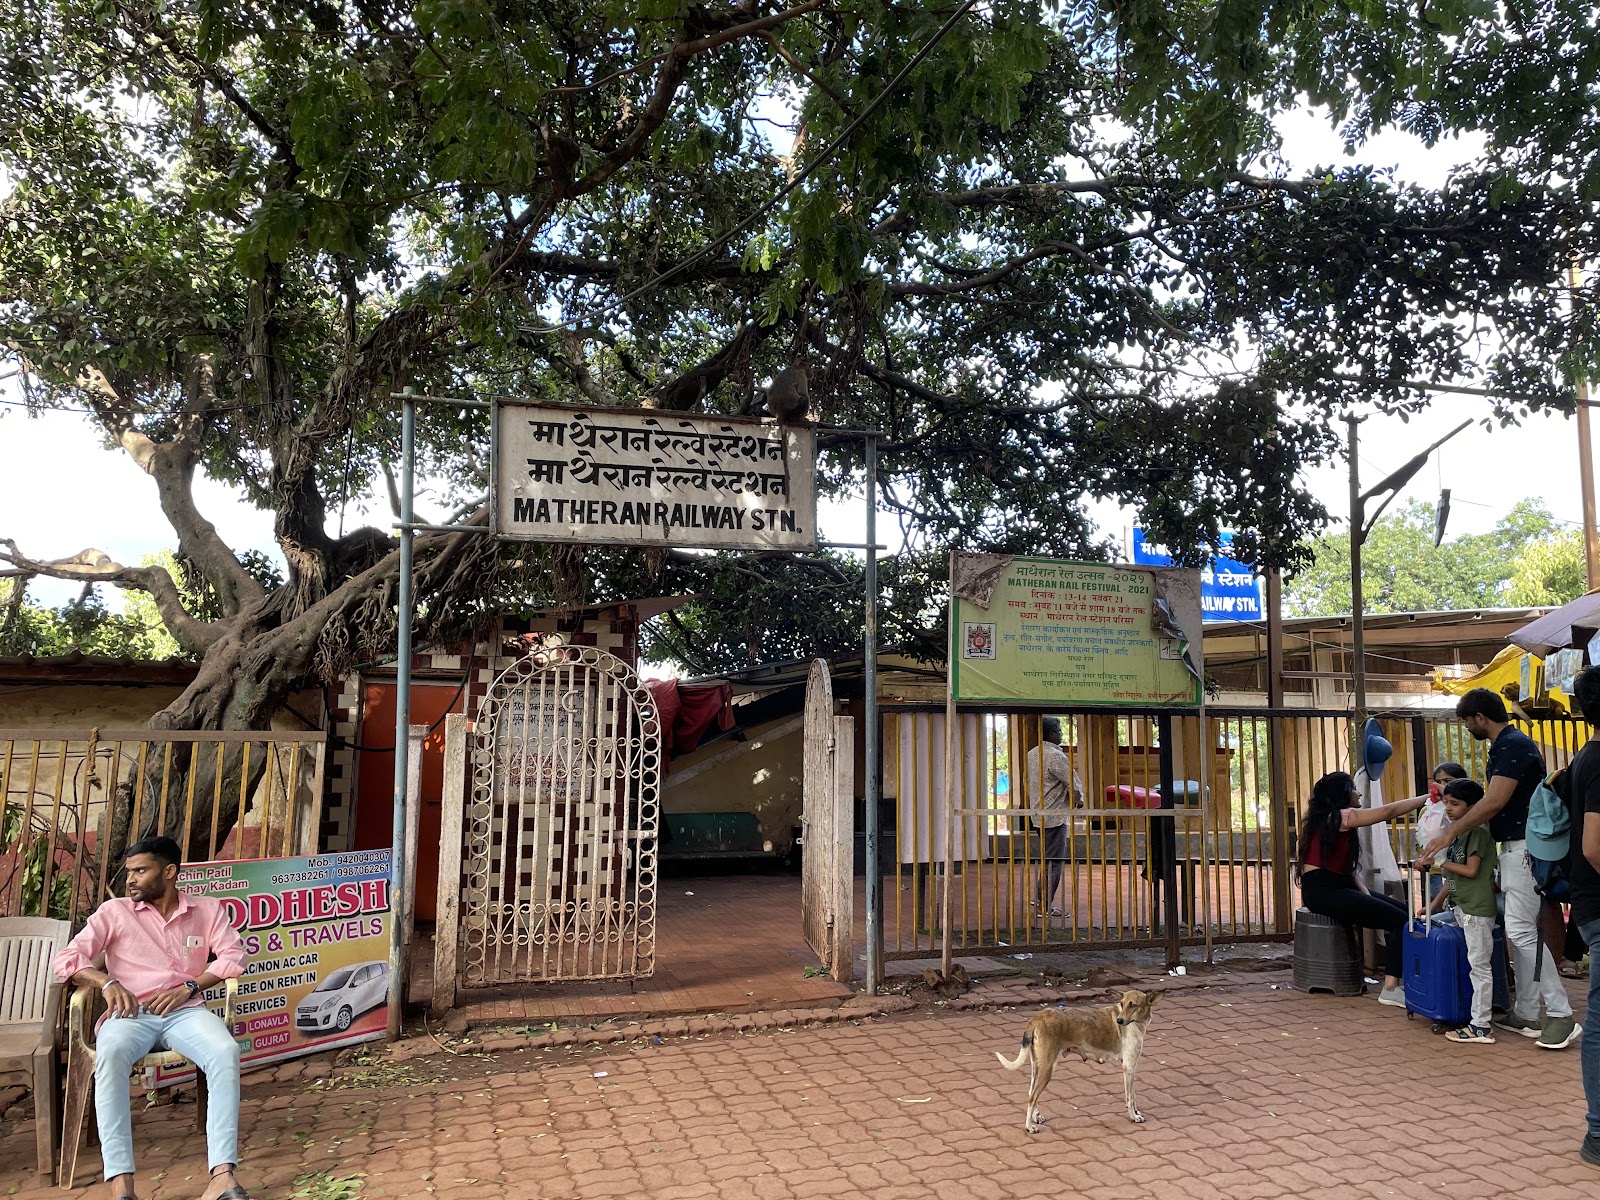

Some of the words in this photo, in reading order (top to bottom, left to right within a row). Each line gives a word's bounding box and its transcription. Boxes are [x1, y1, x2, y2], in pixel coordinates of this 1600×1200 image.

[528, 413, 654, 454] माथेरान
[708, 426, 783, 463] स्टेशन
[527, 450, 656, 491] माथेरान
[706, 460, 786, 497] स्टेशन
[513, 497, 650, 525] MATHERAN
[654, 501, 746, 530] RAILWAY
[751, 508, 803, 533] STN.
[1016, 565, 1056, 578] माथेरान
[1058, 566, 1074, 579] रेल
[1077, 570, 1105, 580] उत्सव
[1217, 568, 1253, 587] स्टेशन
[1008, 578, 1057, 588] MATHERAN
[1060, 580, 1079, 590] RAIL
[1082, 582, 1120, 592] FESTIVAL
[1129, 586, 1149, 594] 2021
[1031, 589, 1056, 599] दिनांक
[1081, 602, 1087, 611] से
[1133, 607, 1146, 615] तक
[1236, 597, 1259, 612] STN.
[1019, 612, 1038, 620] स्थान
[1046, 611, 1073, 621] माथेरान
[1076, 613, 1087, 622] रेल
[1089, 613, 1111, 623] स्टेशन
[1113, 615, 1135, 624] परिसर
[337, 851, 390, 865] 9420040307
[177, 869, 203, 882] chin
[207, 867, 231, 878] Patil
[271, 870, 329, 884] 9637382261
[337, 863, 389, 877] 9987062261
[179, 884, 207, 895] shay
[211, 880, 248, 891] Kadam
[220, 879, 389, 931] DDHESH
[267, 933, 283, 951] &
[288, 918, 383, 948] TRAVELS
[283, 957, 296, 968] AC
[299, 953, 318, 965] CAR
[237, 982, 257, 995] ERE
[260, 979, 274, 991] ON
[277, 974, 303, 988] RENT
[306, 971, 316, 983] IN
[236, 996, 286, 1014] SERVICES
[249, 1015, 289, 1031] LONAVLA
[255, 1033, 289, 1048] GUJRAT
